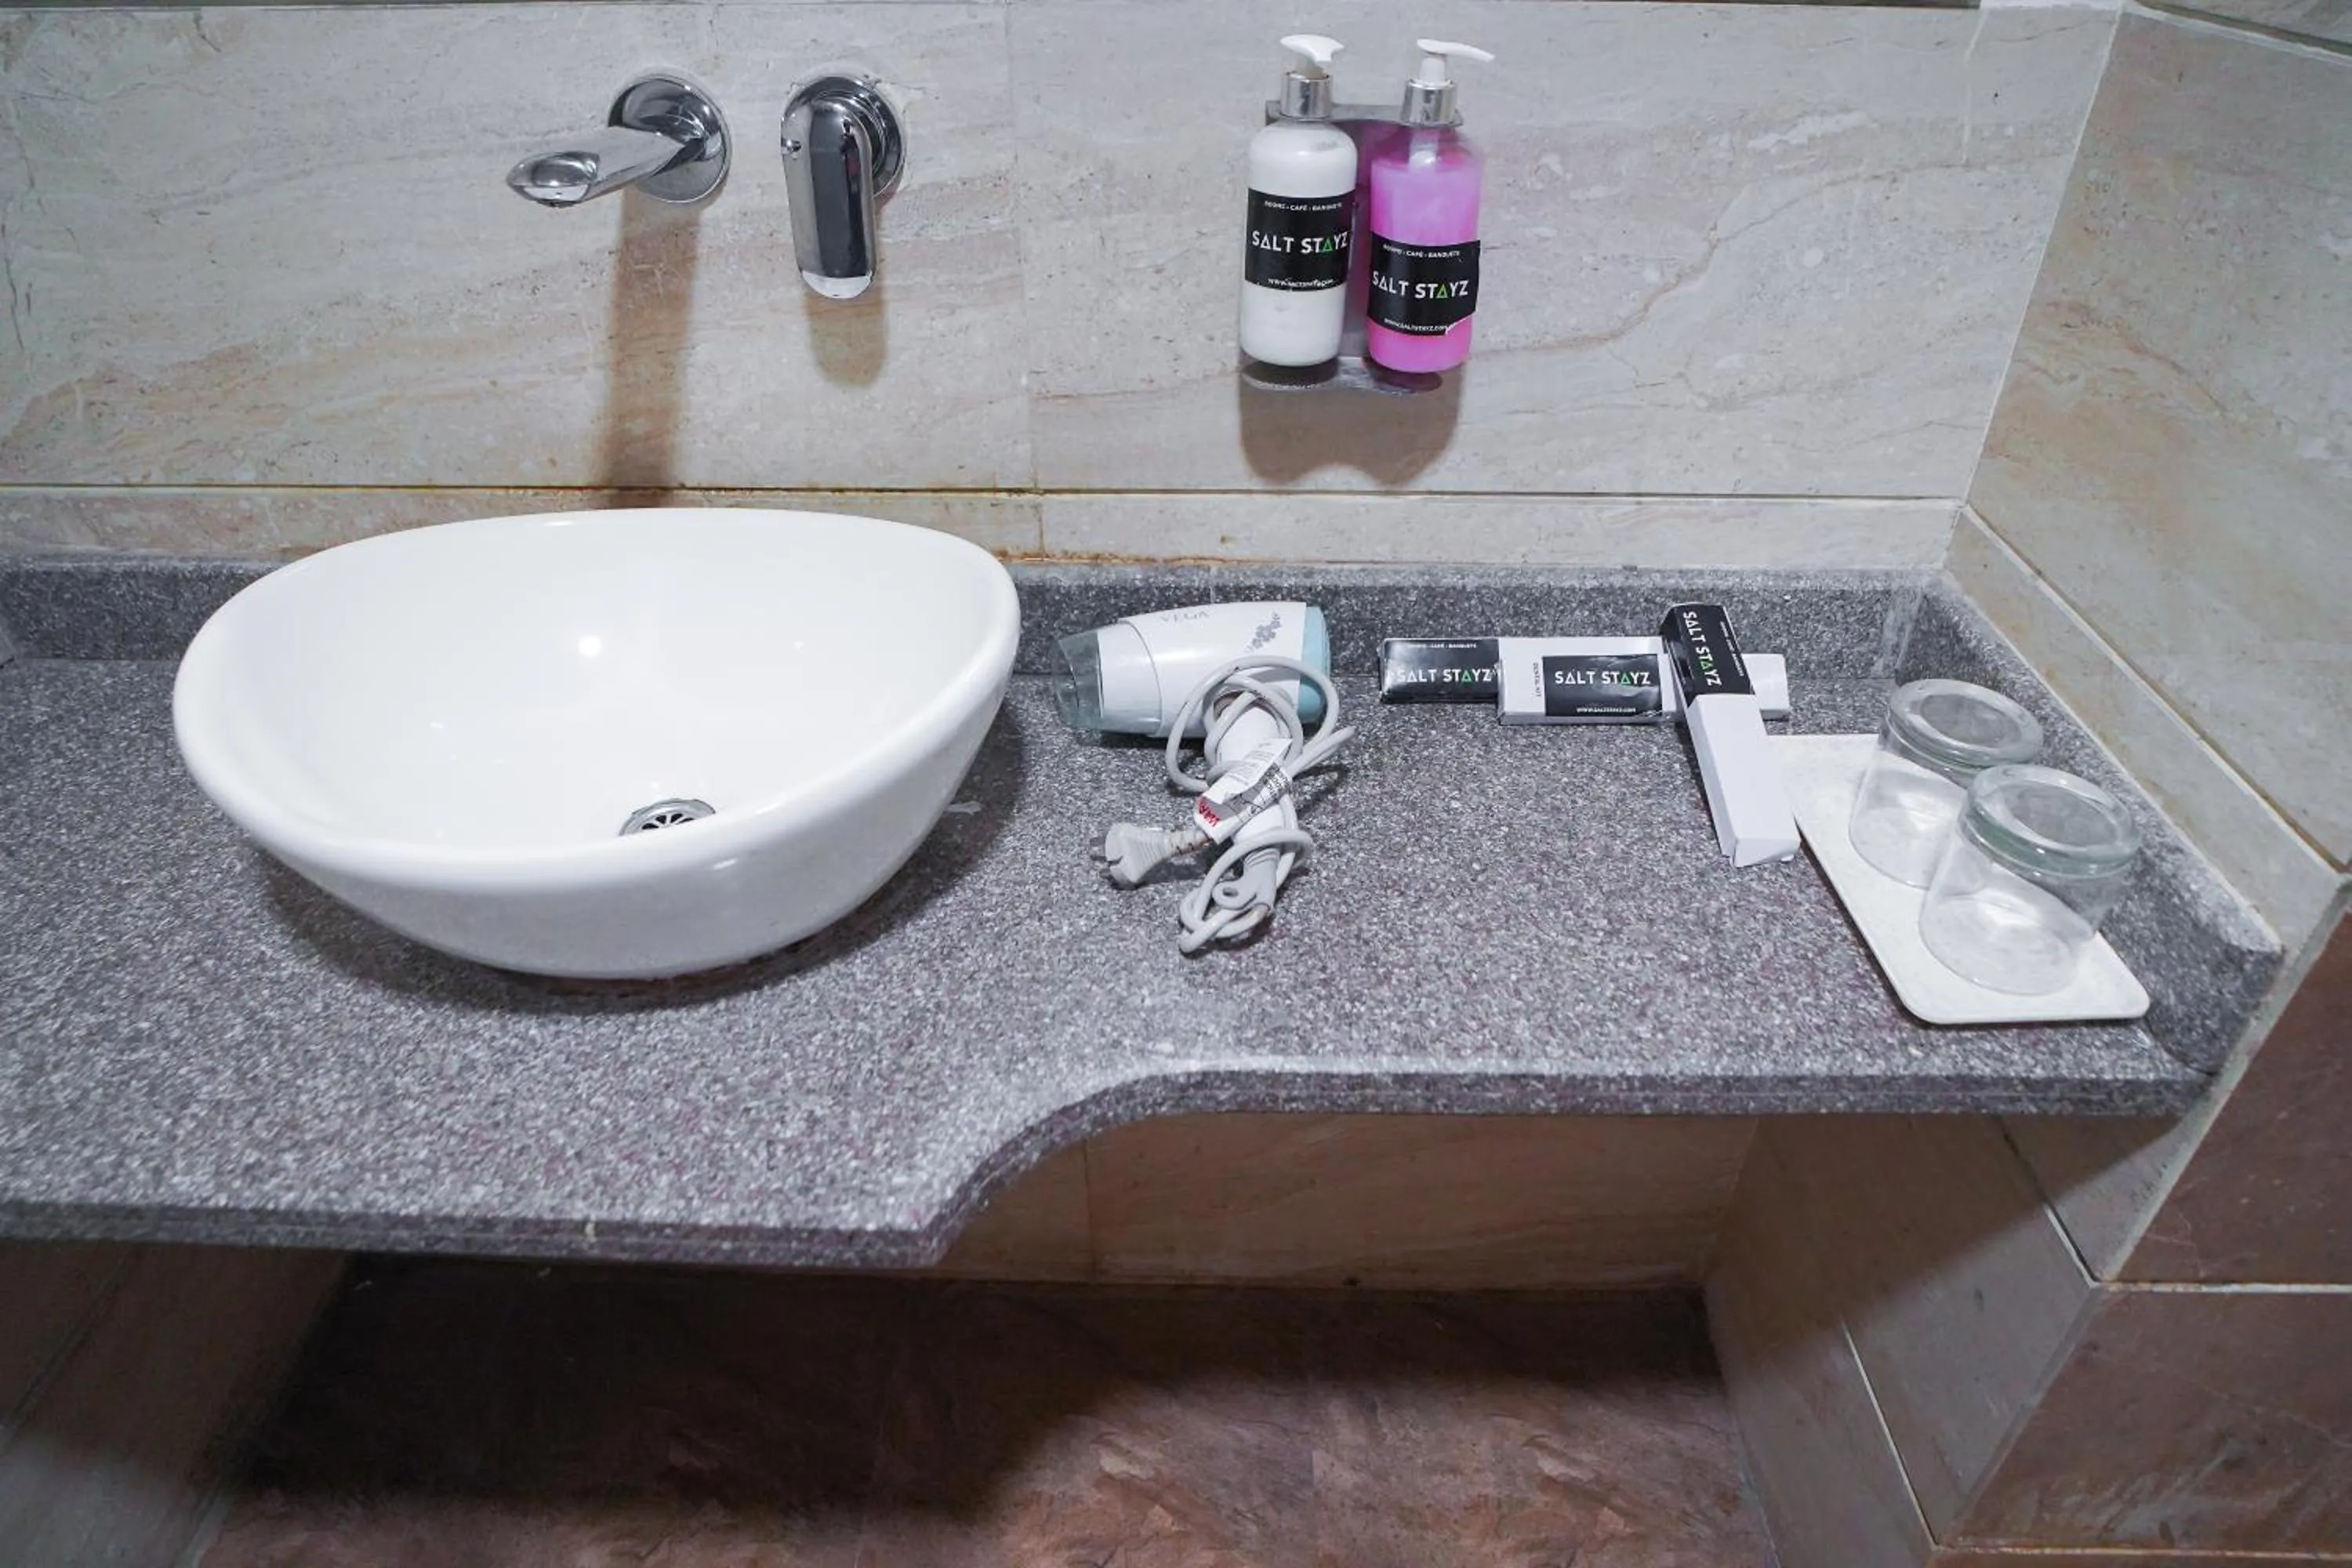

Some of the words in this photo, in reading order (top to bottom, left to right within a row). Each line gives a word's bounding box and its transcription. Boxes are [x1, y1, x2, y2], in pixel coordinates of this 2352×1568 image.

[1251, 230, 1295, 253] SALT
[1301, 230, 1348, 254] STAYZ
[1372, 270, 1409, 296] SALT
[1414, 279, 1469, 299] STAYZ
[1160, 610, 1210, 623] VEGA
[1682, 612, 1707, 642] SALT
[1695, 646, 1722, 686] STAYZ
[1396, 669, 1437, 683] SALT
[1443, 669, 1493, 683] STAYZ
[1554, 671, 1596, 684] SALT
[1602, 671, 1651, 685] STAYZ
